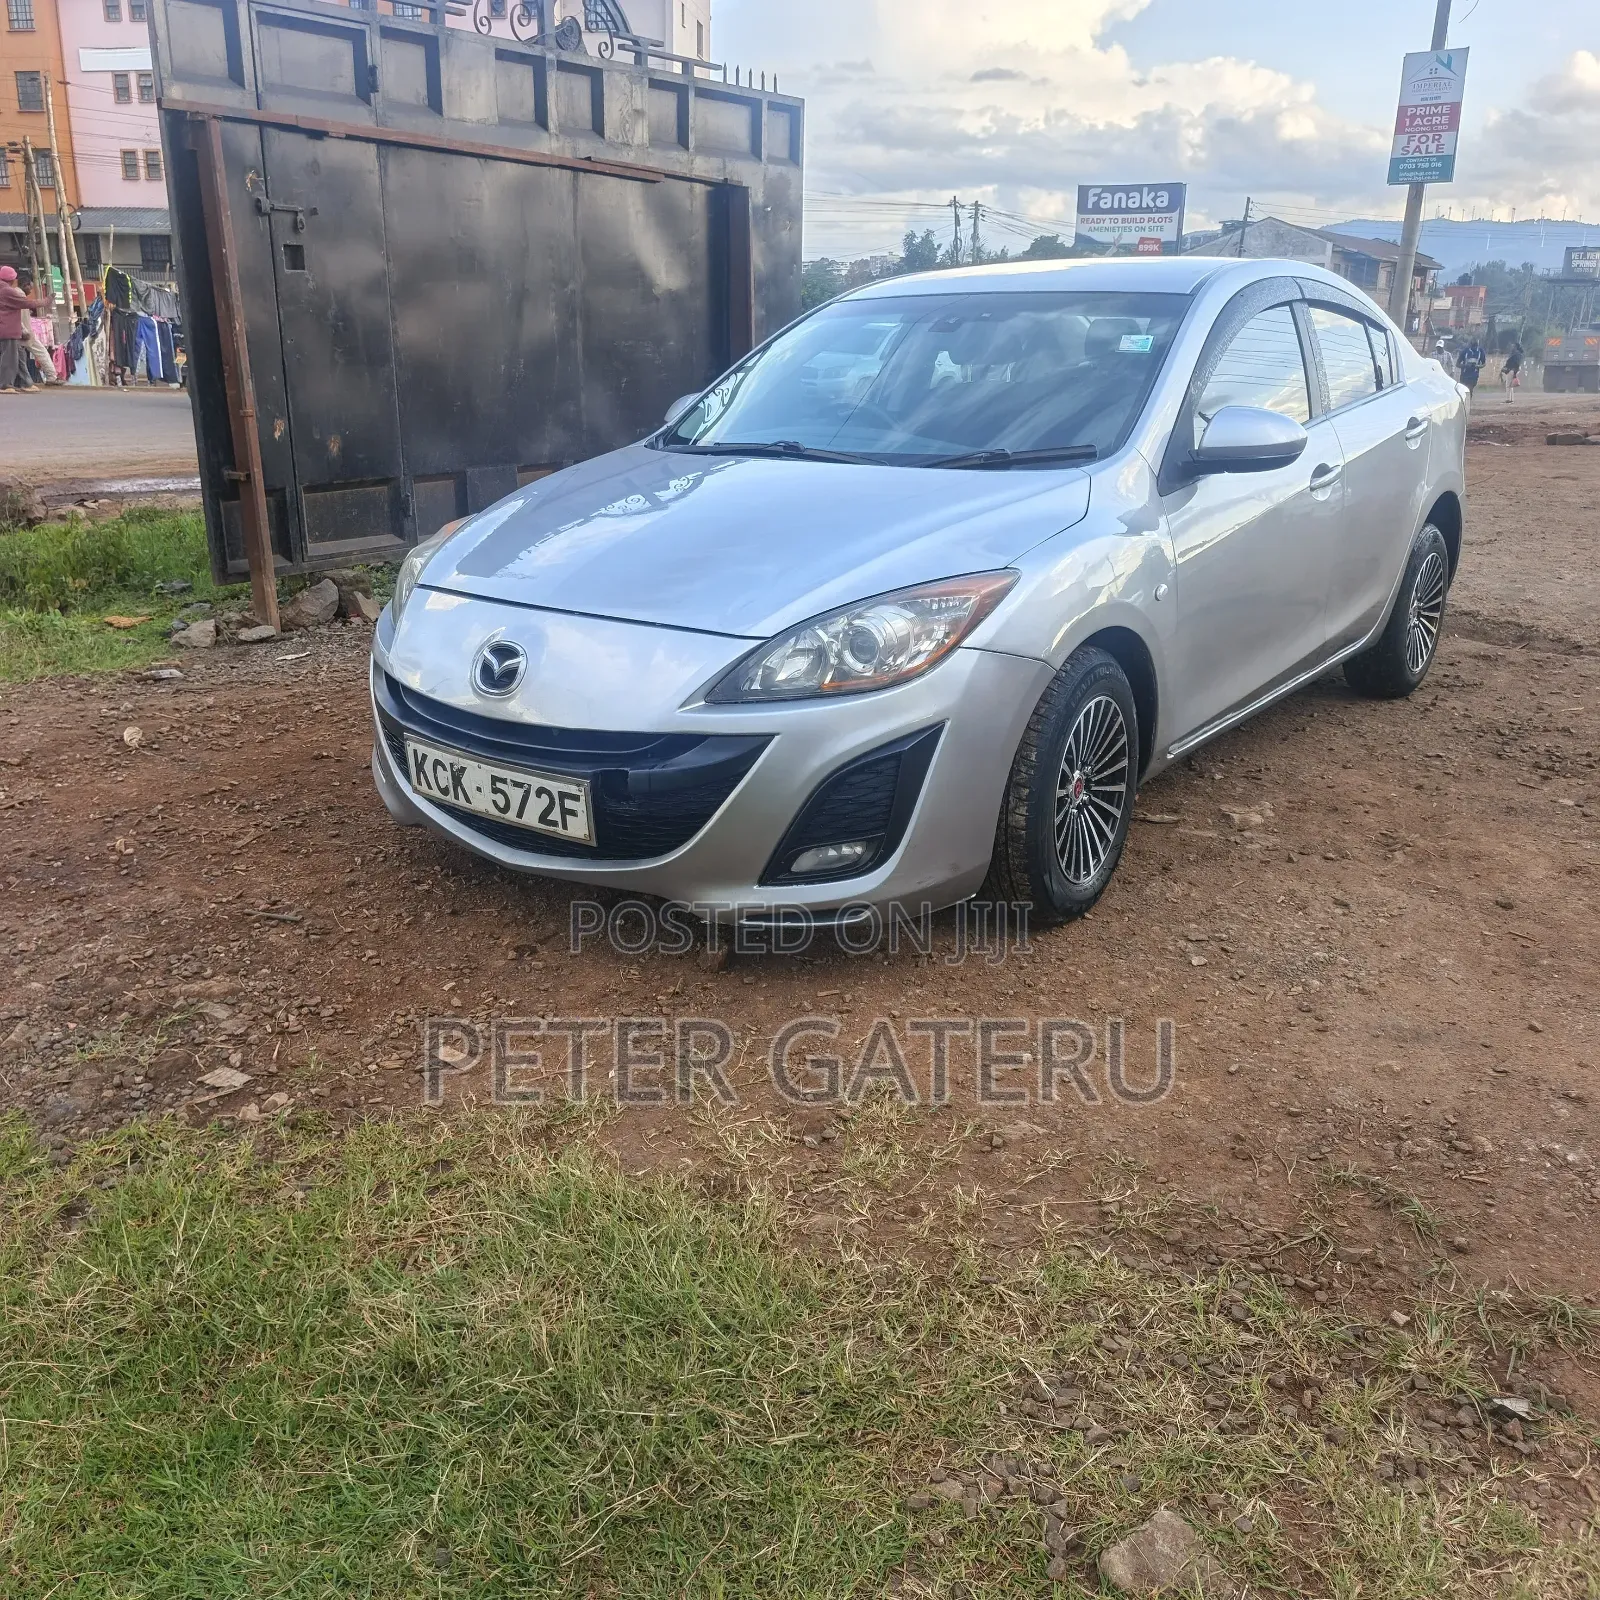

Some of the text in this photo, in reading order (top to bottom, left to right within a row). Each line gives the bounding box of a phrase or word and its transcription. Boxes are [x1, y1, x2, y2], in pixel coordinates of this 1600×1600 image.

[1413, 81, 1452, 89] IMPERIAL
[1407, 105, 1451, 116] PRIME
[1405, 116, 1450, 127] 1 ACRE
[1407, 133, 1443, 145] FOR
[1400, 144, 1445, 156] SALE
[1087, 187, 1169, 209] Fanaka
[1081, 217, 1107, 225] READY
[1147, 216, 1173, 224] PLOTS
[1138, 244, 1160, 252] 899K
[412, 749, 581, 831] KCK 572F
